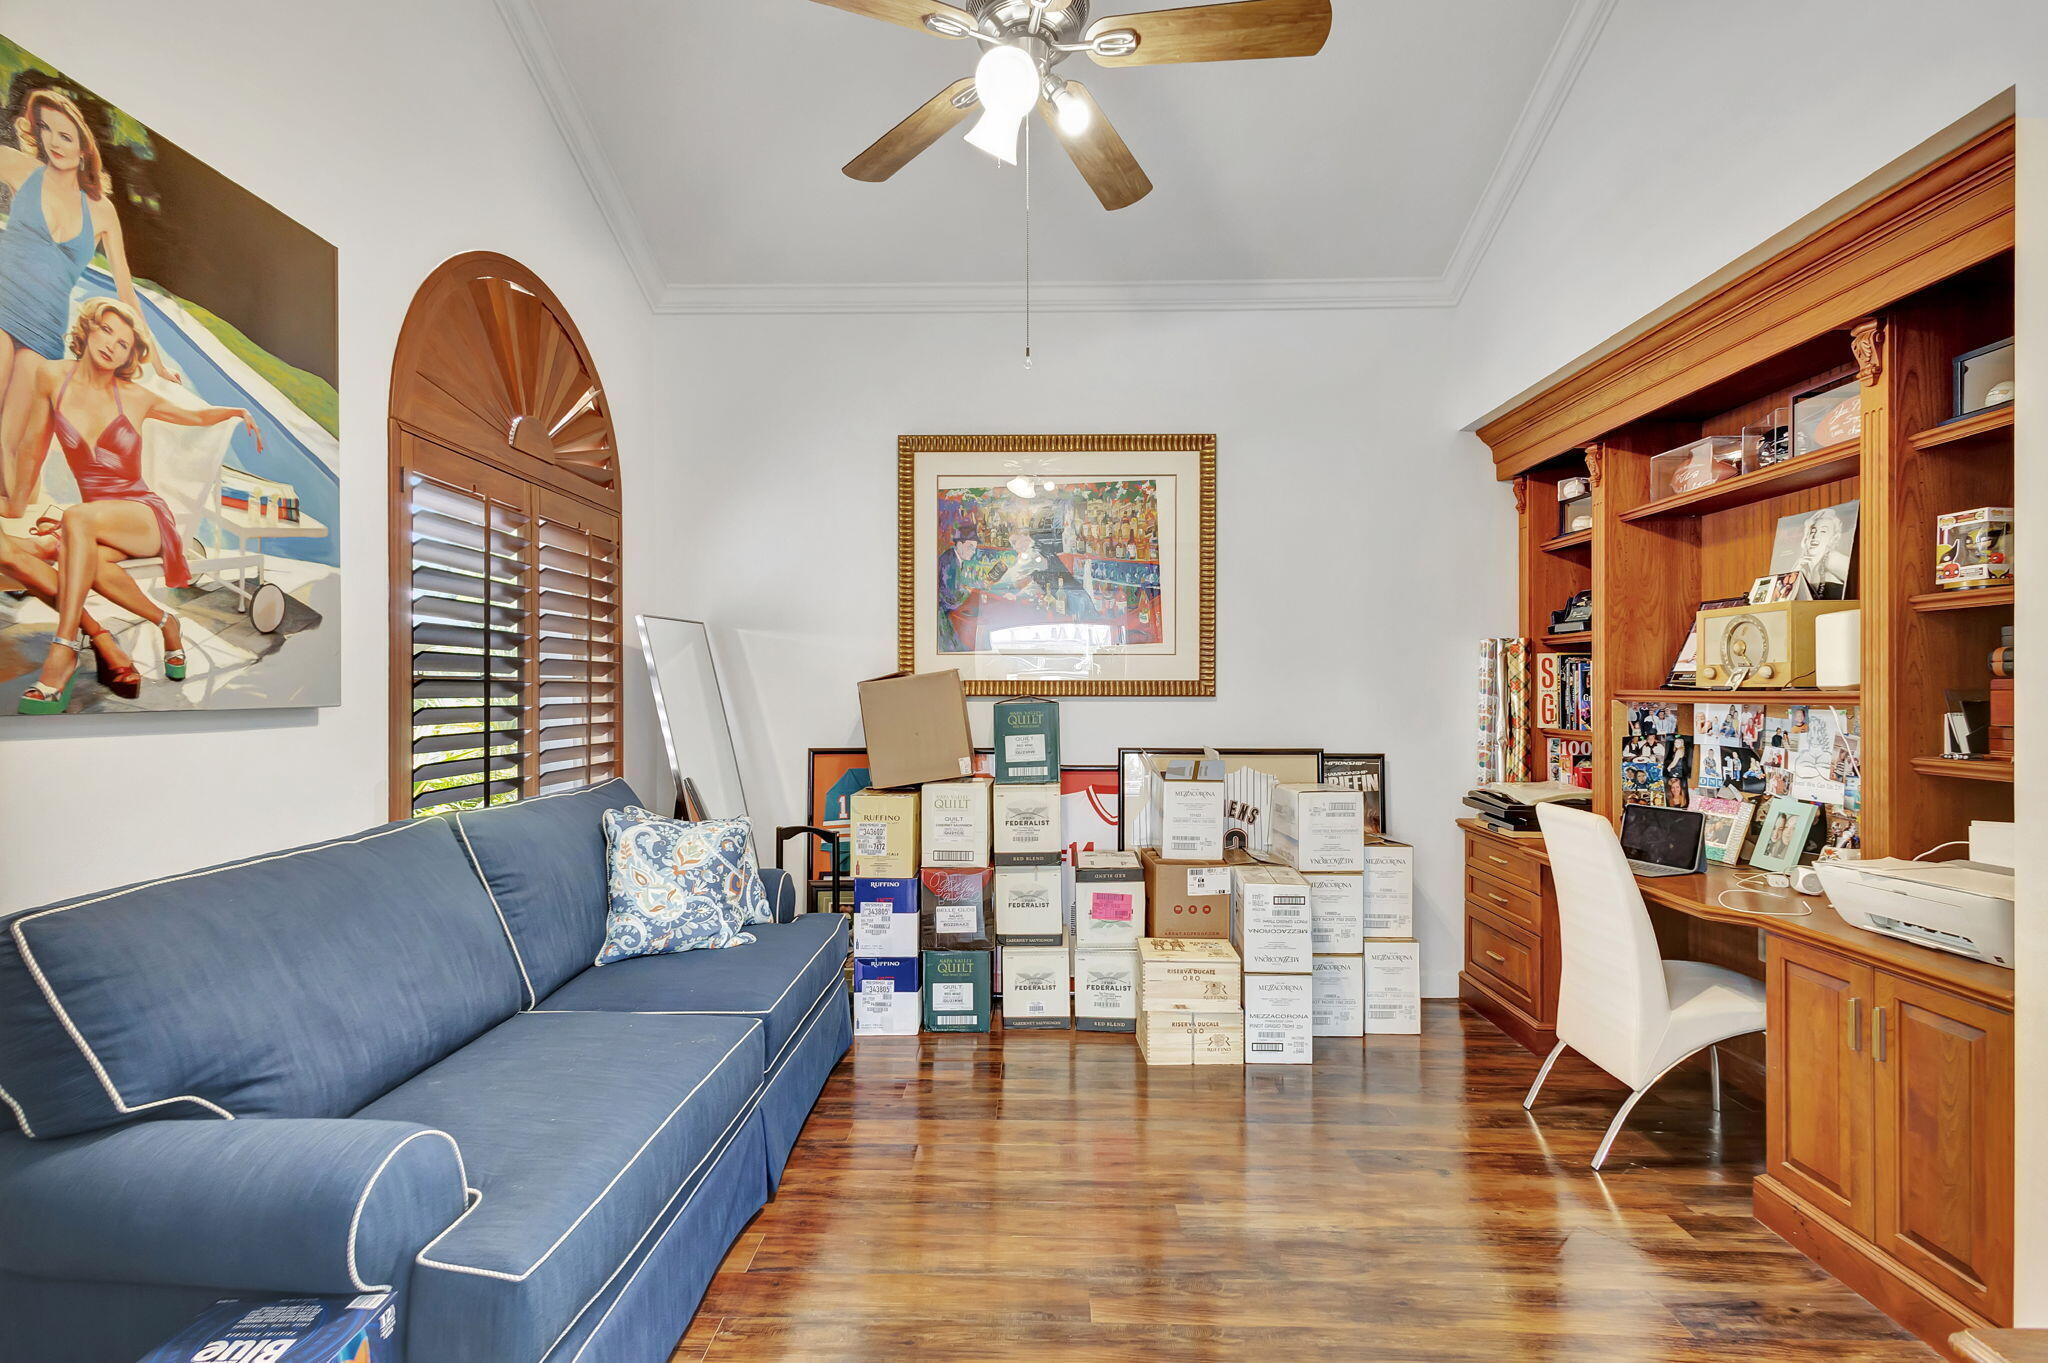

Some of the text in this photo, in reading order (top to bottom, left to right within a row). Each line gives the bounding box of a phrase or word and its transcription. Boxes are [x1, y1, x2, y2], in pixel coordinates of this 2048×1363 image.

[1007, 714, 1044, 725] QUILT
[1324, 773, 1379, 792] RIFFIN
[1175, 790, 1215, 799] MEZZACORONA
[934, 799, 971, 809] QUILT
[1223, 799, 1260, 825] ENS
[863, 814, 901, 822] RUFFINO
[937, 962, 974, 973] QUILT
[1312, 964, 1351, 972] EZZACORONA
[1086, 984, 1132, 992] FEDERALIST
[1258, 984, 1303, 992] MEZZACORONA
